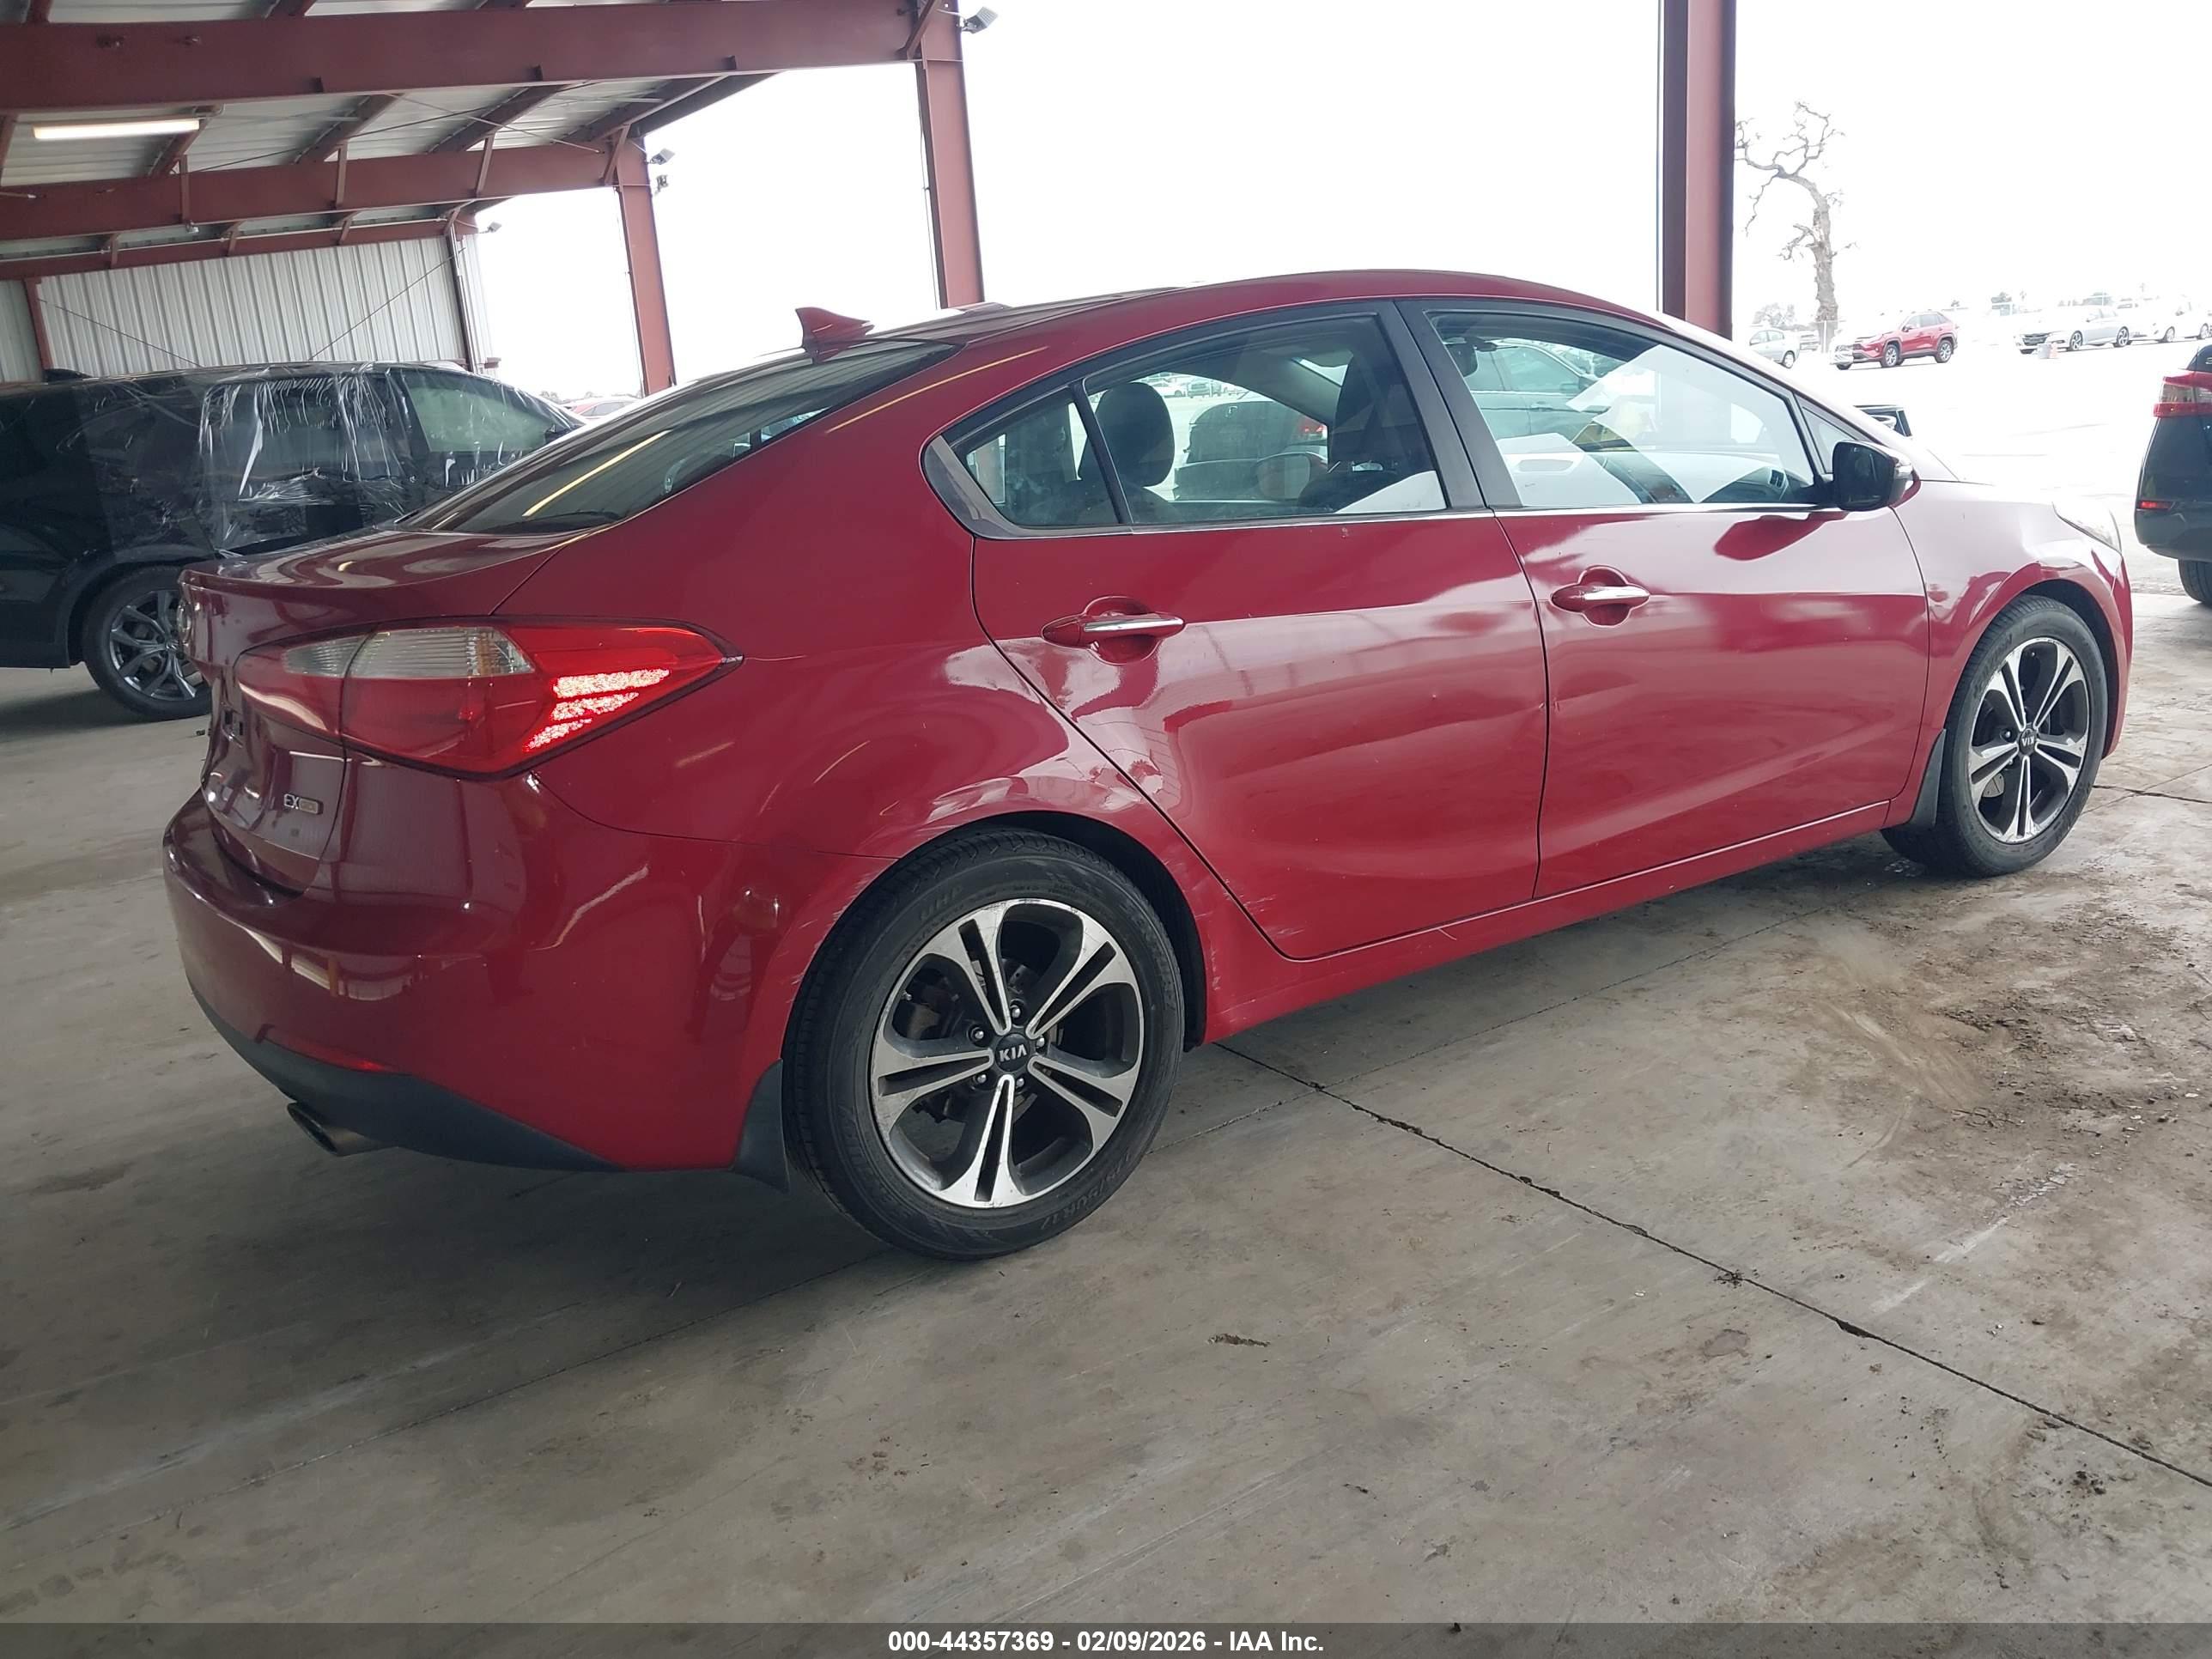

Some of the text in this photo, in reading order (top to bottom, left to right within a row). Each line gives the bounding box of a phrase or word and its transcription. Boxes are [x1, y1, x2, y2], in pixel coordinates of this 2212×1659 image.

[2021, 736, 2034, 747] KIA
[283, 793, 300, 810] EX
[999, 1043, 1027, 1062] KIA
